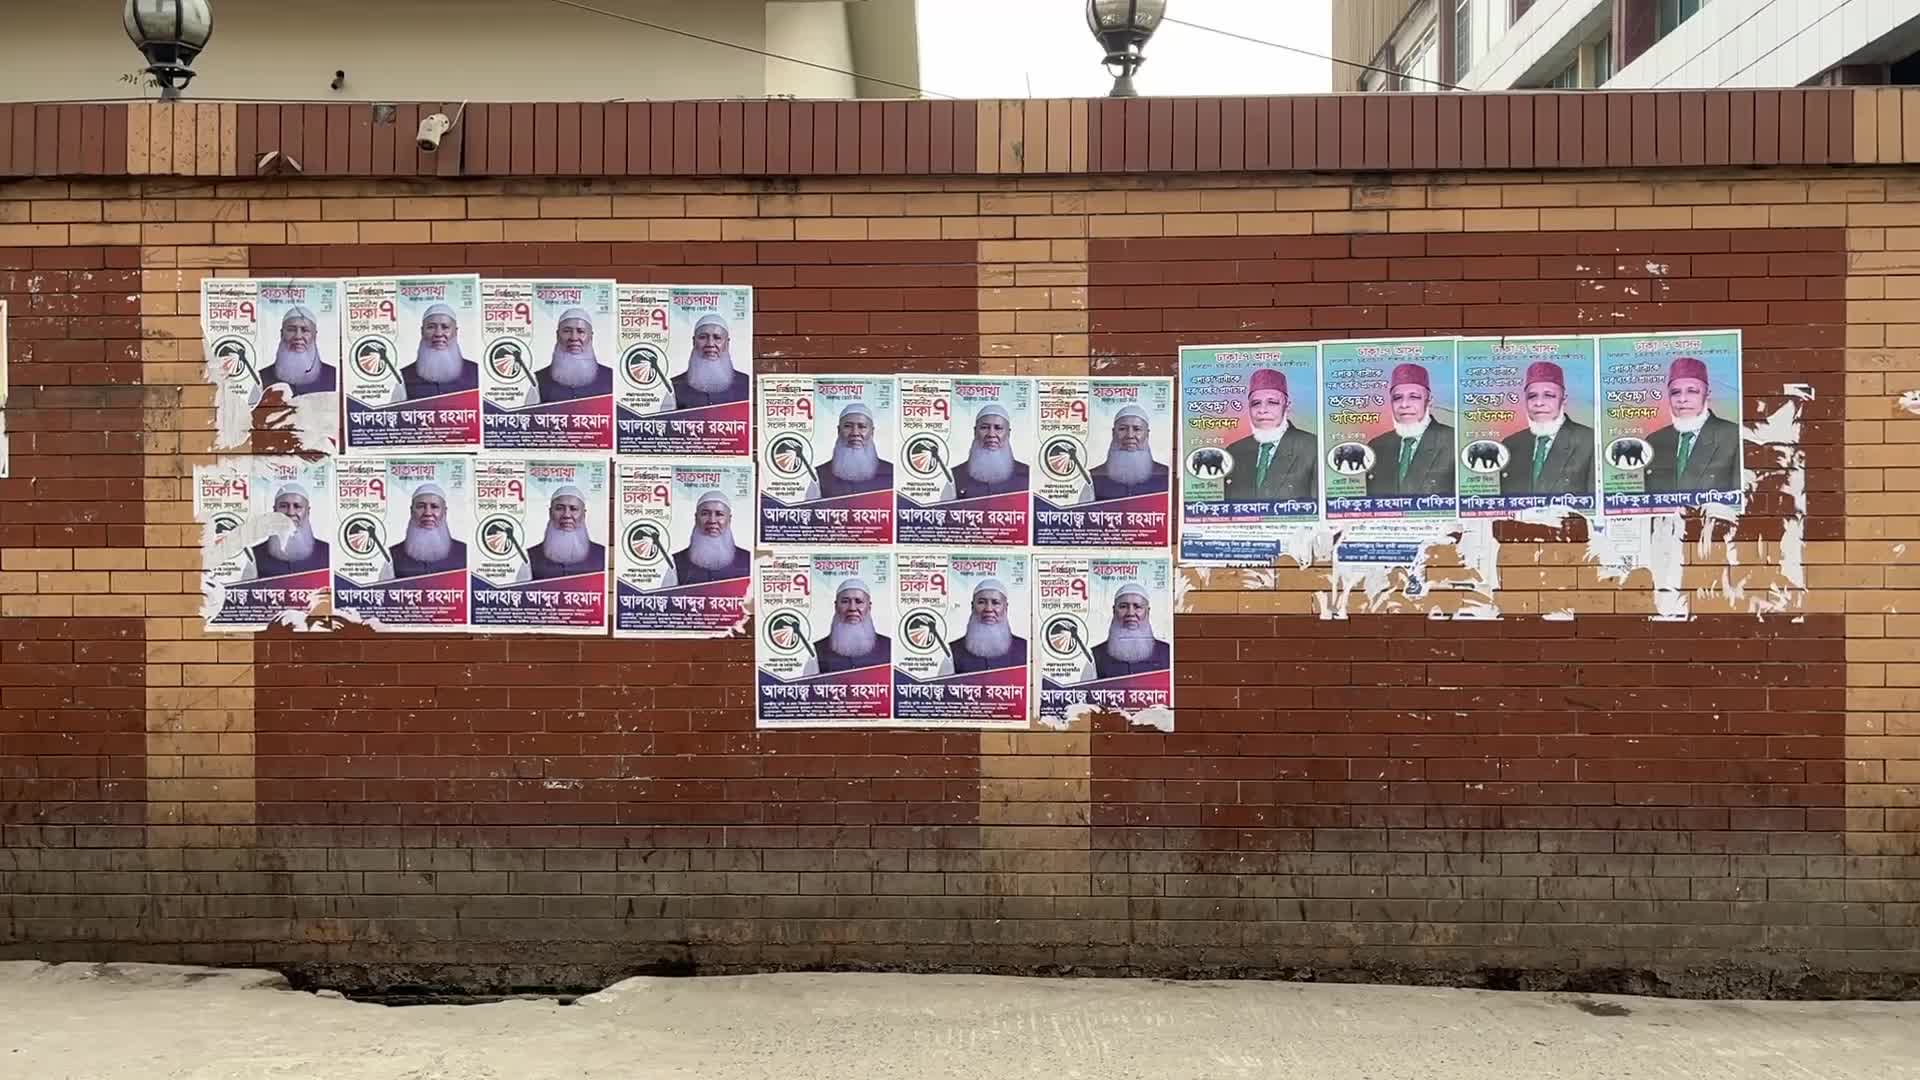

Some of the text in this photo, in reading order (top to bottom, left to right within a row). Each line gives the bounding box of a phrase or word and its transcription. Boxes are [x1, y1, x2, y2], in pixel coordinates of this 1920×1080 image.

[400, 285, 444, 296] হাতপাখা
[536, 289, 581, 299] হাতপাখা
[673, 295, 717, 305] হাতপাখা
[818, 384, 862, 395] হাতপাখা
[955, 385, 999, 396] হাতপাখা
[1092, 387, 1138, 397] হাতপাখা
[1650, 390, 1661, 400] ও
[1372, 396, 1384, 405] ও
[1507, 394, 1518, 403] ও
[1231, 401, 1242, 411] ও
[438, 407, 477, 425] রহমান
[571, 413, 610, 429] রহমান
[707, 419, 746, 435] রহমান
[390, 465, 434, 475] হাতপাখা
[529, 467, 574, 477] হাতপাখা
[675, 472, 720, 482] হাতপাখা
[1461, 493, 1593, 509] শফিকুর রহমান (শফিক)
[1605, 488, 1739, 506] শফিকুর রহমান (শফিক)
[1185, 499, 1317, 515] শফিকুর রহমান (শফিক)
[1327, 496, 1372, 511] শফিকুর
[1375, 497, 1412, 508] রহমান
[852, 507, 890, 523] রহমান
[987, 509, 1025, 525] রহমান
[1126, 510, 1165, 527] রহমান
[814, 560, 859, 570] হাতপাখা
[951, 560, 996, 571] হাতপাখা
[1092, 565, 1137, 575] হাতপাখা
[426, 588, 464, 604] রহমান
[563, 590, 602, 606] রহমান
[850, 682, 889, 699] রহমান
[985, 683, 1024, 700] রহমান
[1128, 688, 1167, 704] রহমান
